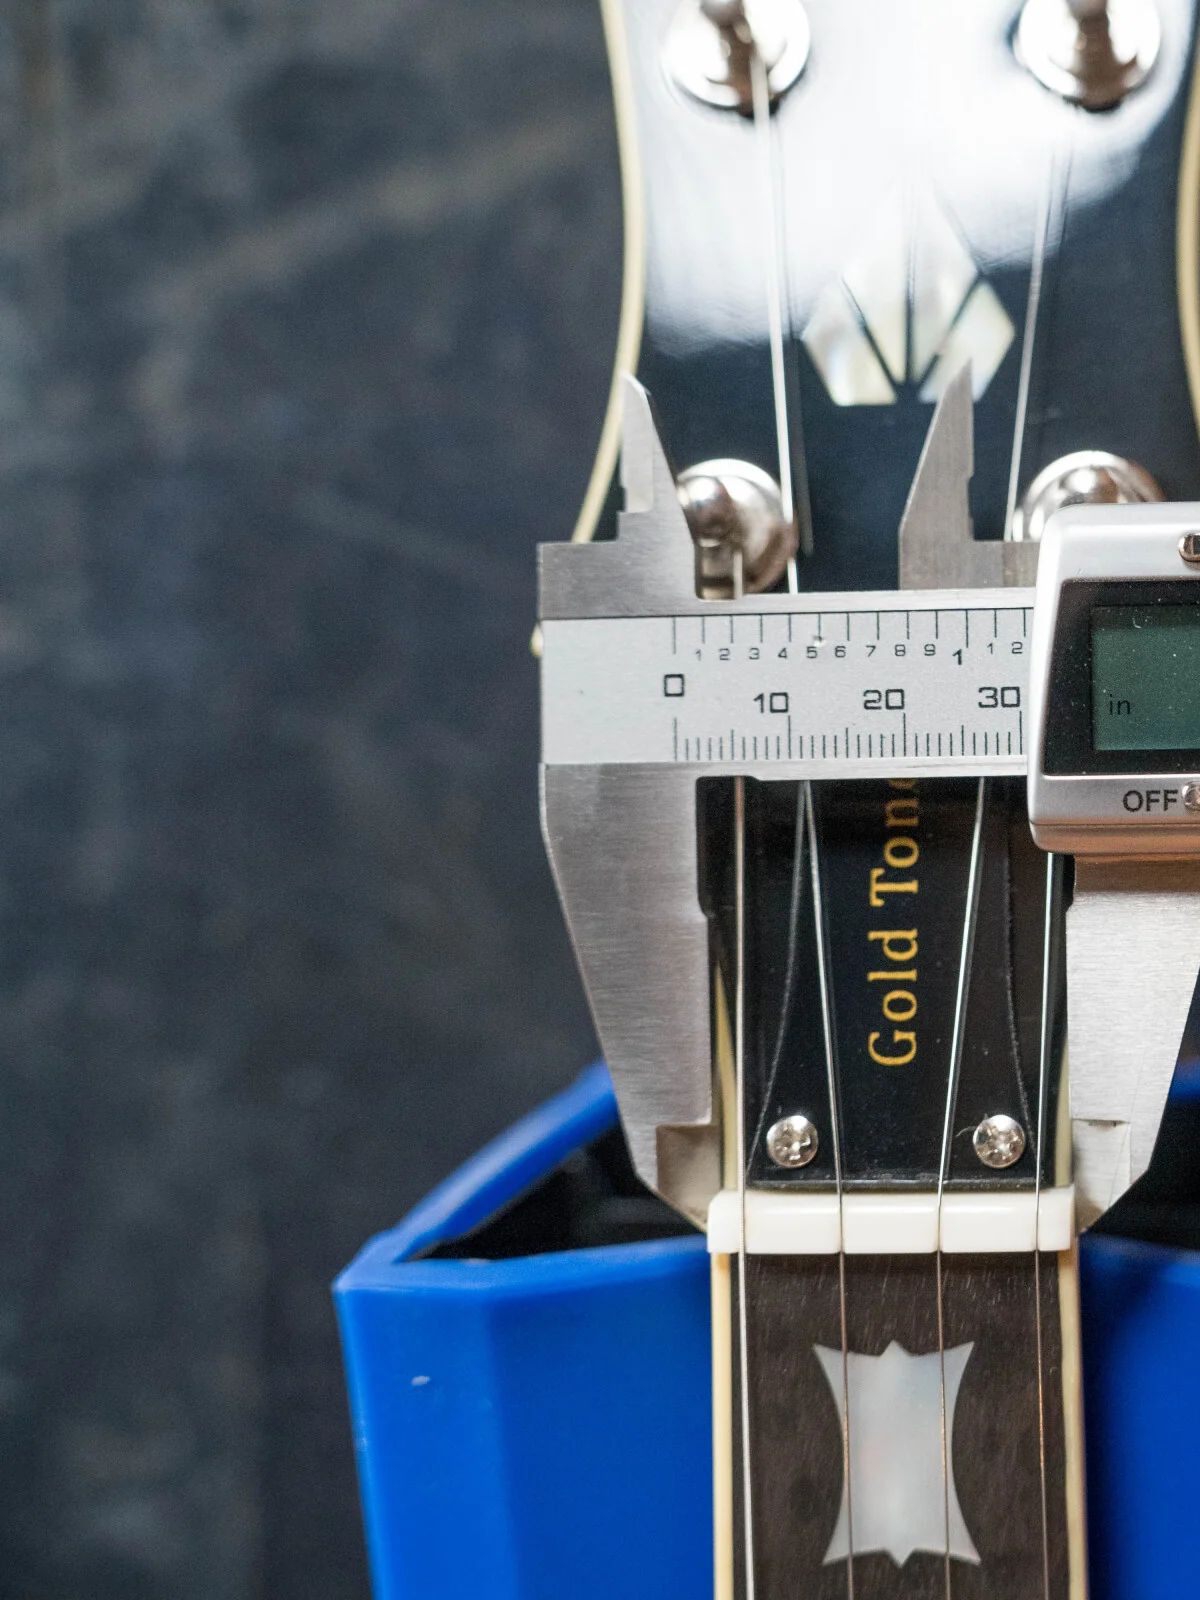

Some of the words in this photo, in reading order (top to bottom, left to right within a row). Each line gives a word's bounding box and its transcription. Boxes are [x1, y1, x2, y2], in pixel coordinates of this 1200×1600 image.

[718, 648, 731, 661] 2
[748, 648, 760, 660] 3
[777, 648, 788, 659] 4
[806, 646, 818, 659] 5
[834, 645, 847, 658] 6
[865, 645, 877, 658] 7
[894, 644, 906, 657] 8
[924, 643, 936, 657] 9
[952, 648, 963, 666] 1
[1011, 641, 1024, 655] 2
[753, 692, 789, 713] 10
[863, 688, 905, 710] 20
[978, 686, 1021, 709] 30
[1108, 693, 1132, 716] in
[1123, 789, 1179, 812] OFF
[867, 928, 918, 1066] Gold
